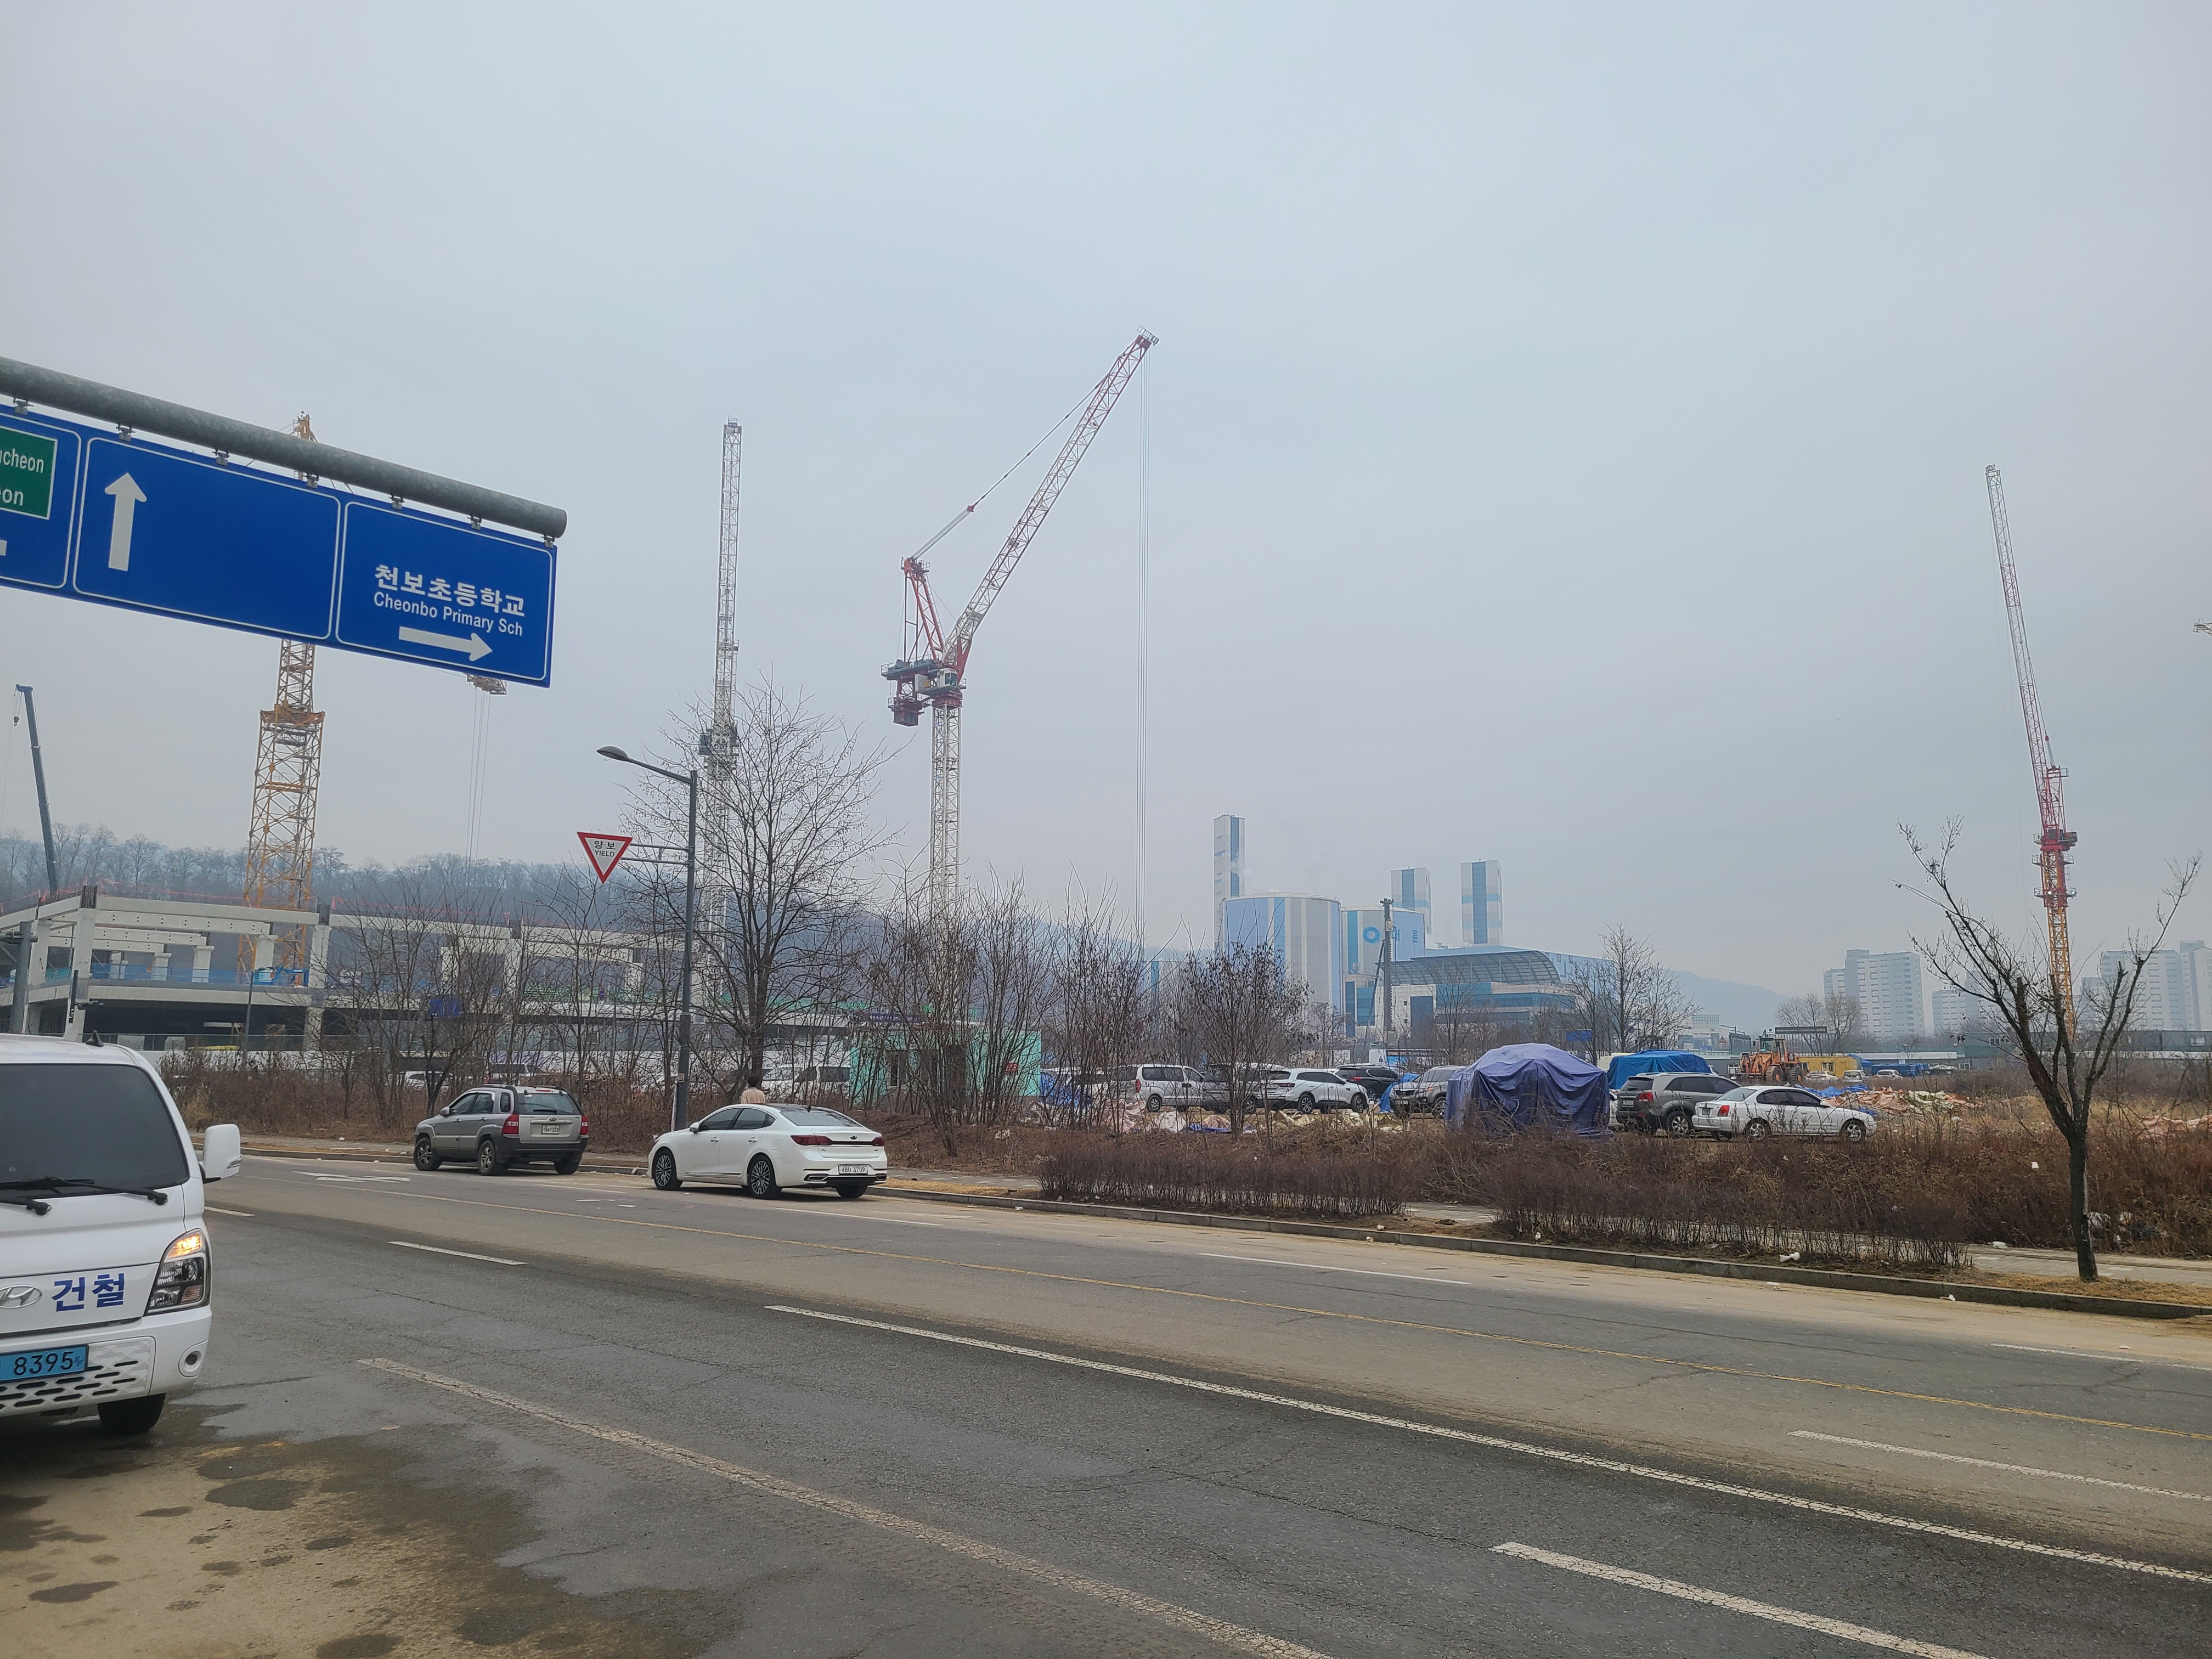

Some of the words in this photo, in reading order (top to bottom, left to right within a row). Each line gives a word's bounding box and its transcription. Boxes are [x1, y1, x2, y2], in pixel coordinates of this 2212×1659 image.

[0, 488, 24, 506] on
[375, 565, 524, 617] 천보초등학교
[374, 591, 438, 618] Cheonbo
[443, 606, 494, 633] Primary
[498, 618, 523, 636] Sch
[52, 1273, 125, 1312] 건철
[13, 1351, 74, 1376] 8395
